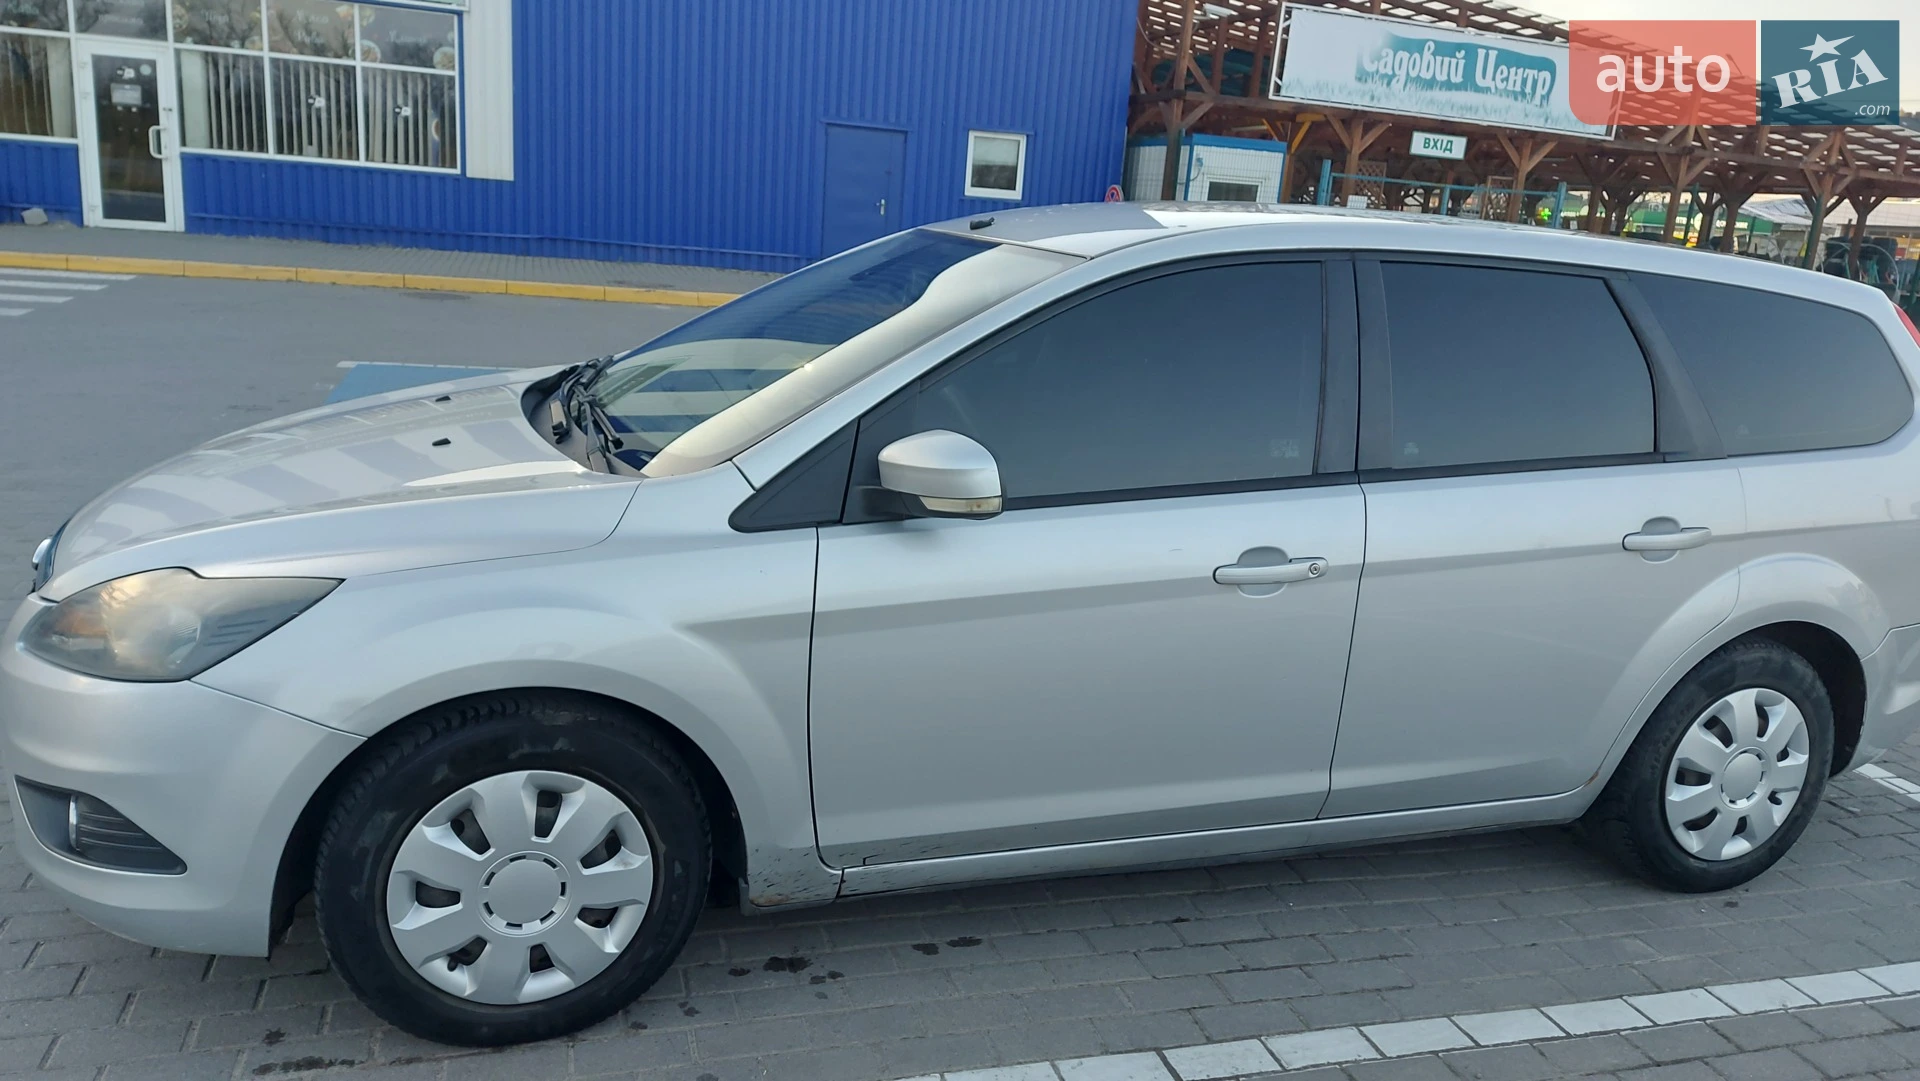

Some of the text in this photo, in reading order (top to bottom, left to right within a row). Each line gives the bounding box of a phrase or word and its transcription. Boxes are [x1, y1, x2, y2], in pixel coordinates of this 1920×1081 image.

[1362, 41, 1551, 104] Садовий Центр
[1422, 136, 1454, 154] ВХІД
